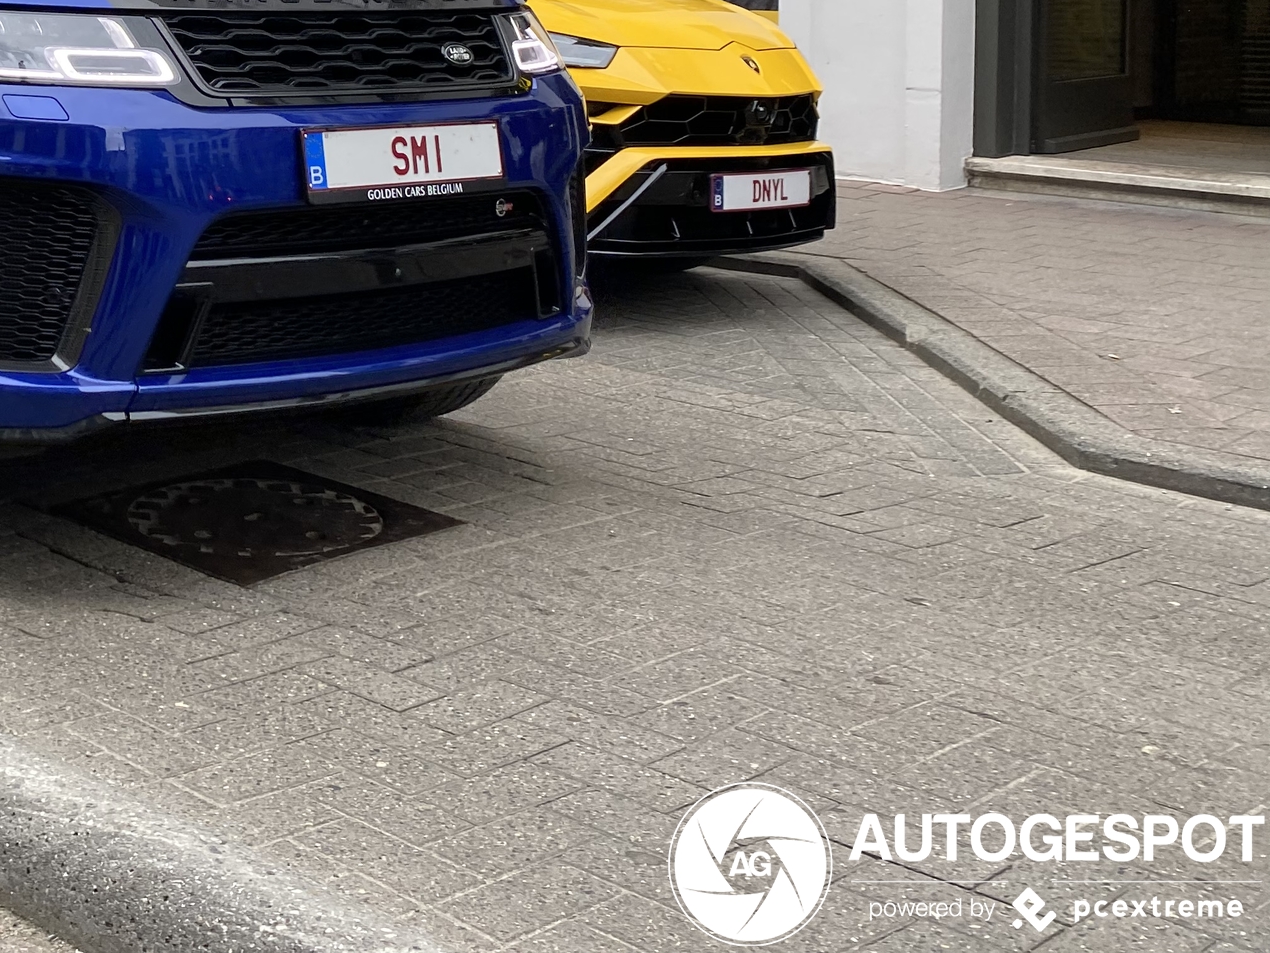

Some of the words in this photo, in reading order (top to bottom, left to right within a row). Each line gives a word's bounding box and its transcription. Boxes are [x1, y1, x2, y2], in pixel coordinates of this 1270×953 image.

[310, 166, 324, 184] B
[367, 186, 403, 200] GOLDEN
[404, 185, 426, 198] CARS
[428, 183, 464, 196] BELGIUM
[752, 178, 788, 202] DNYL
[714, 194, 722, 206] B
